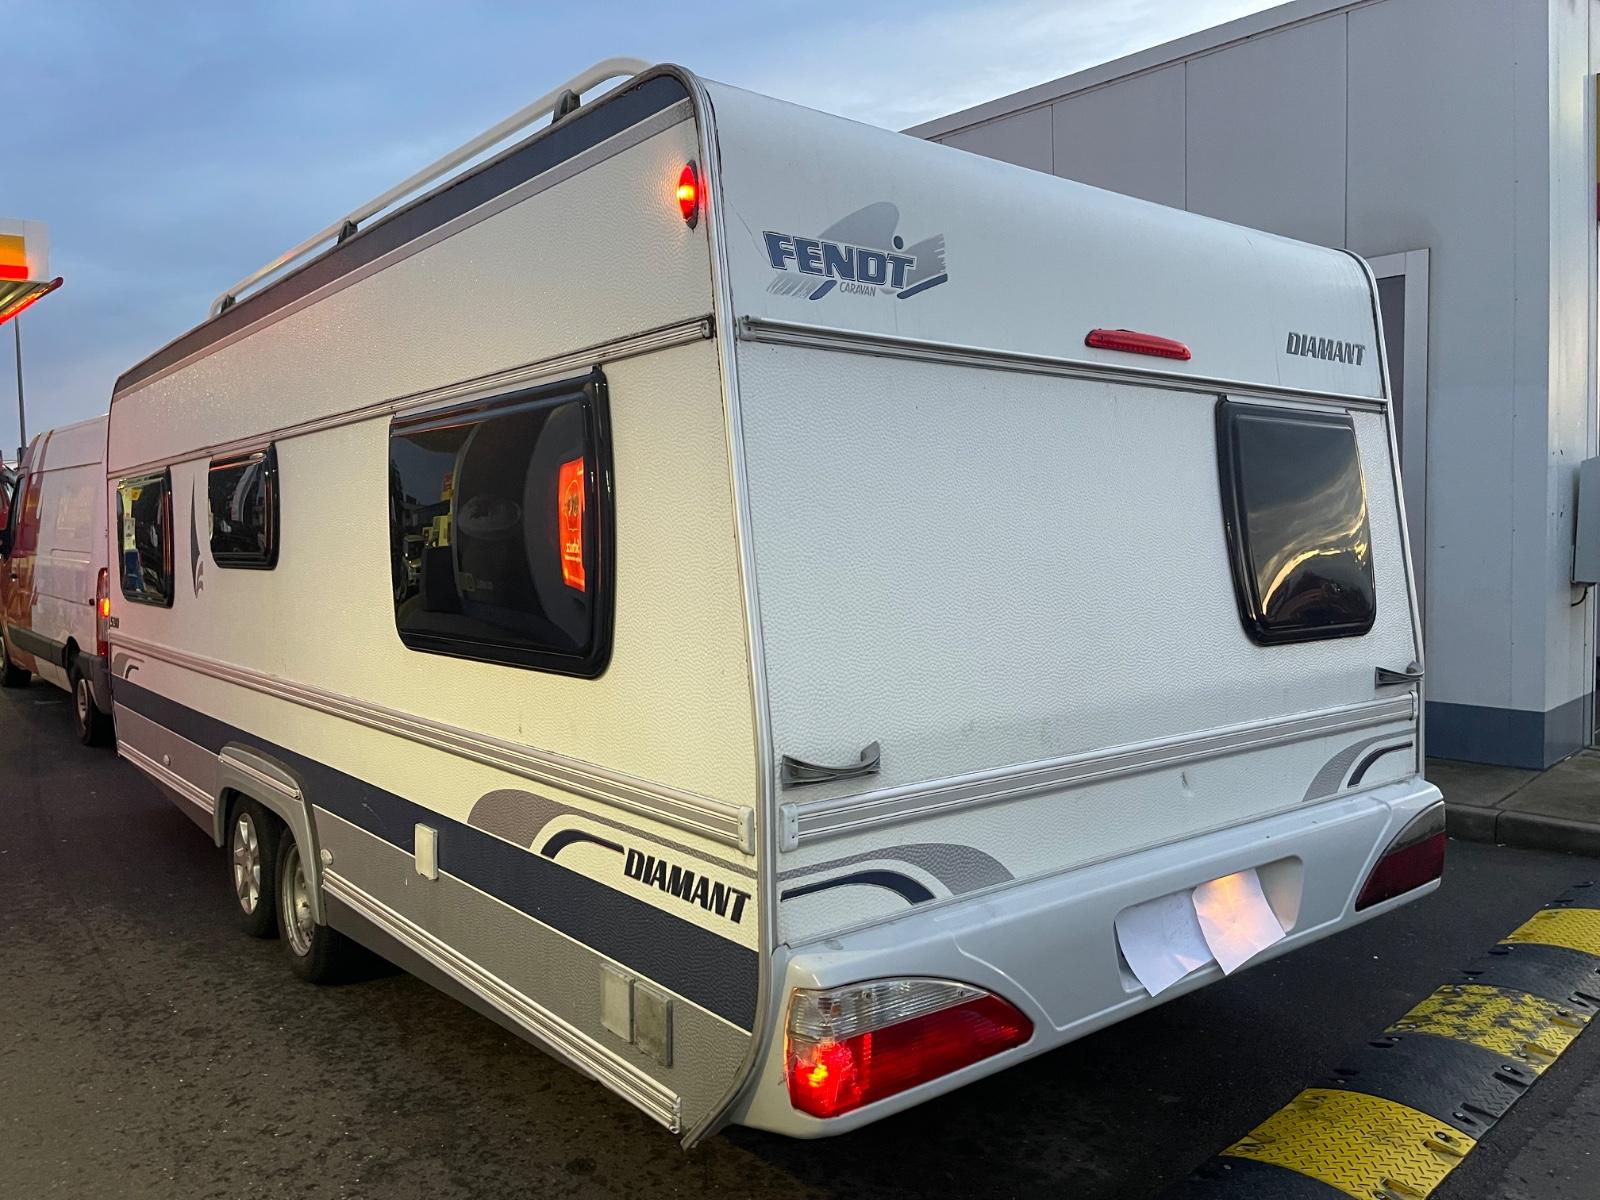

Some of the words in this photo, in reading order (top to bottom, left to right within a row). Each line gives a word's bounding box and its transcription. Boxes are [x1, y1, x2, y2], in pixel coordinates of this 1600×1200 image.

[762, 230, 917, 289] FENDT
[839, 281, 876, 297] CARAVAN
[1286, 331, 1366, 366] DIAMANT
[623, 847, 752, 924] DIAMANT
